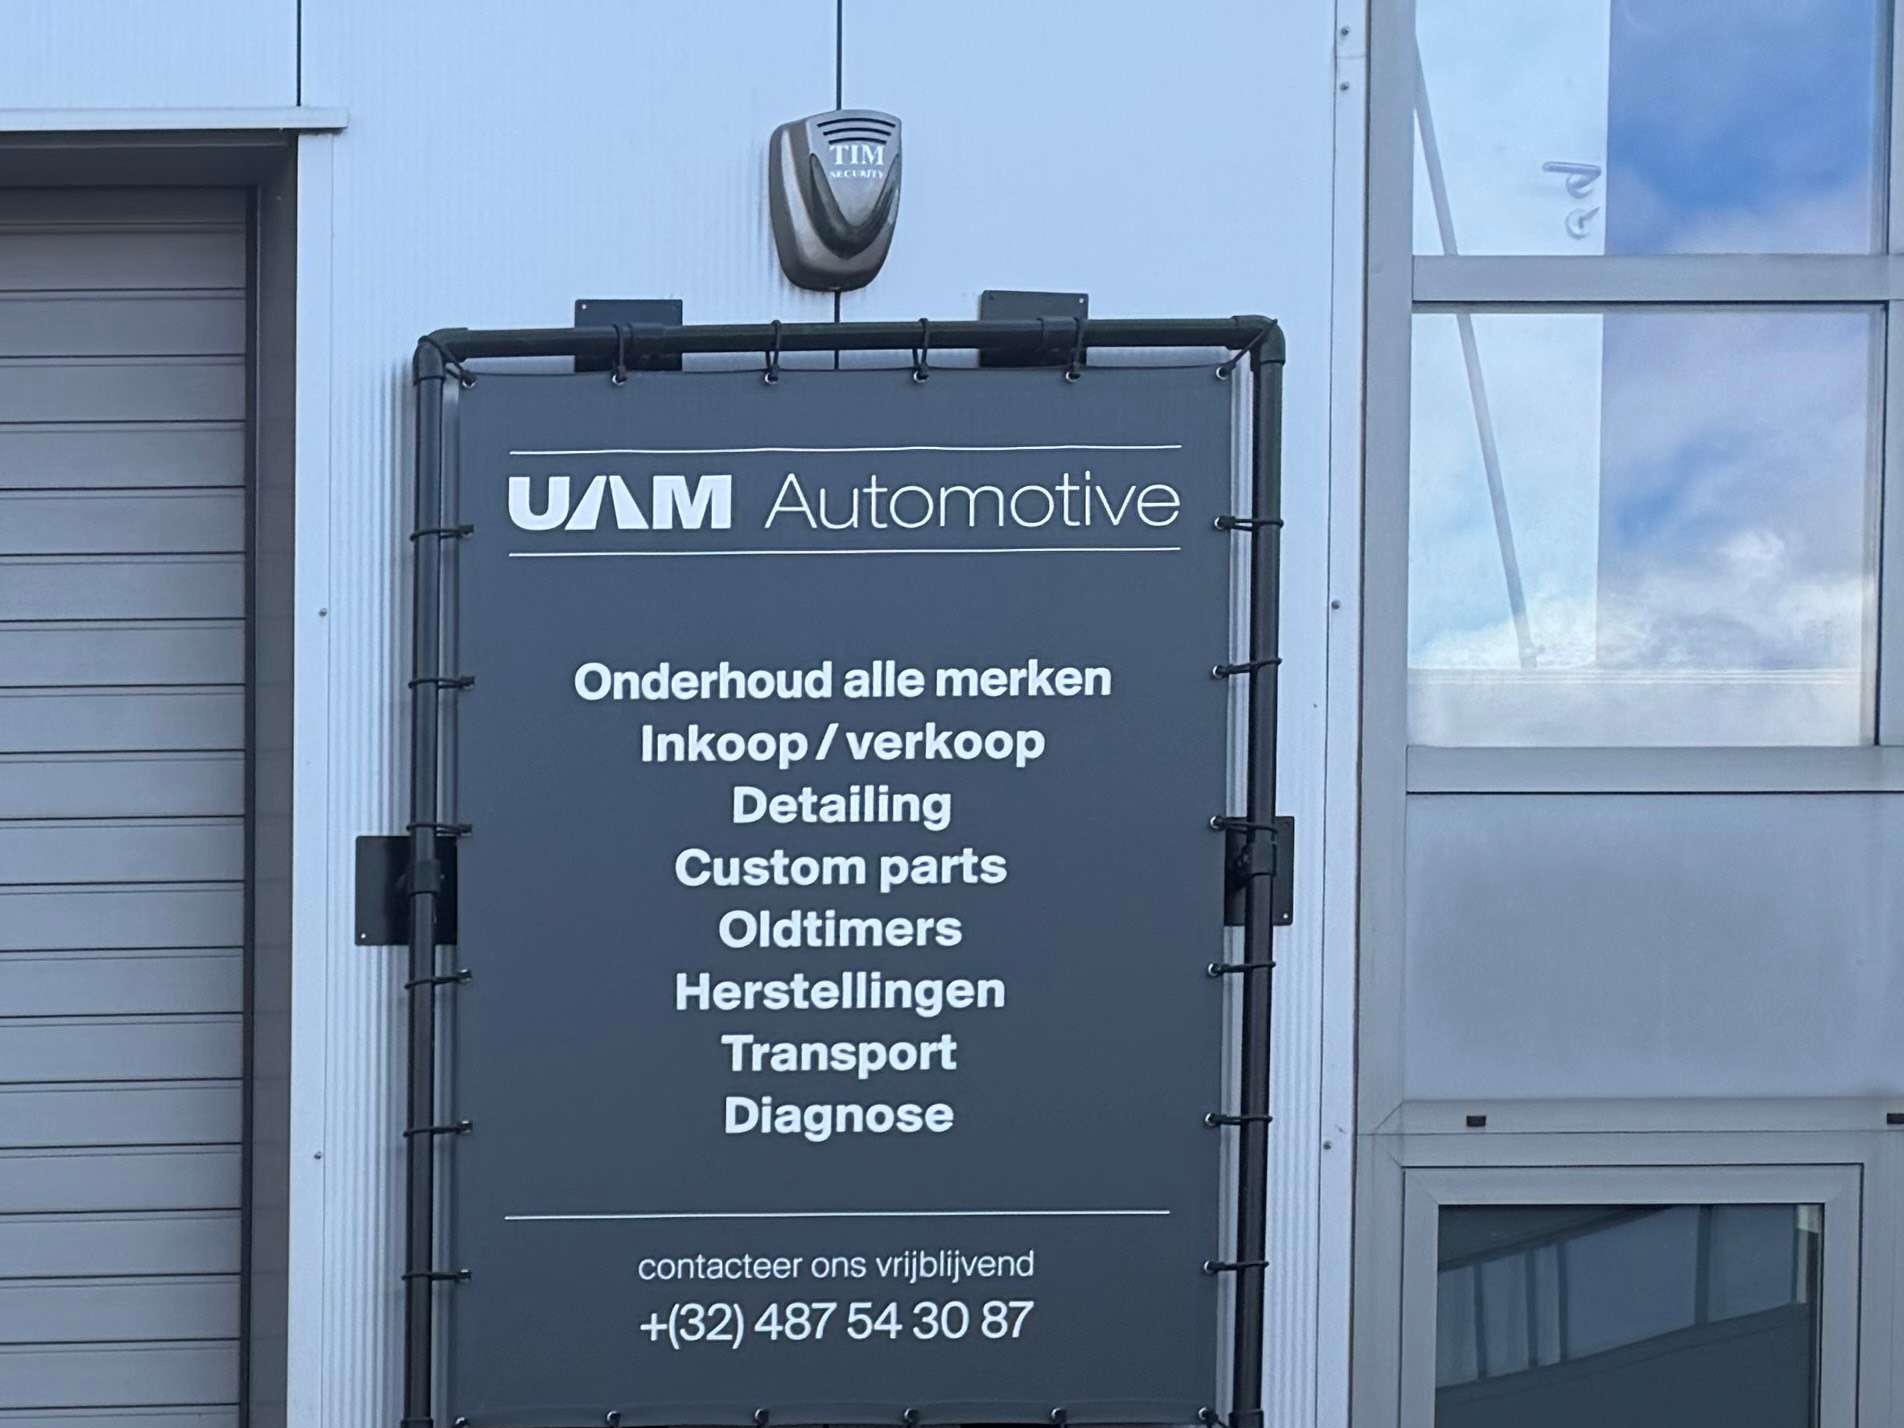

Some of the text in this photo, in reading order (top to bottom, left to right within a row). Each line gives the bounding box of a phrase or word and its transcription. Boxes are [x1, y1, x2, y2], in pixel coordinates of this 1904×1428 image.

[828, 144, 884, 165] TIM
[508, 470, 1181, 531] UAM Automotive
[574, 658, 1112, 701] Onderhoud alle merken
[642, 724, 809, 770] Inkoop
[845, 721, 1046, 768] verkoop
[733, 784, 952, 832] Detailing
[675, 847, 1008, 894] Custom parts
[718, 909, 963, 949] Oldtimers
[676, 971, 1005, 1018] Herstellingen
[720, 1033, 958, 1080] Transport
[725, 1096, 954, 1143] Diagnose
[638, 1249, 1034, 1284] contacteer ons vrijblijvend
[640, 1300, 1035, 1350] +(32) 487 54 30 87
